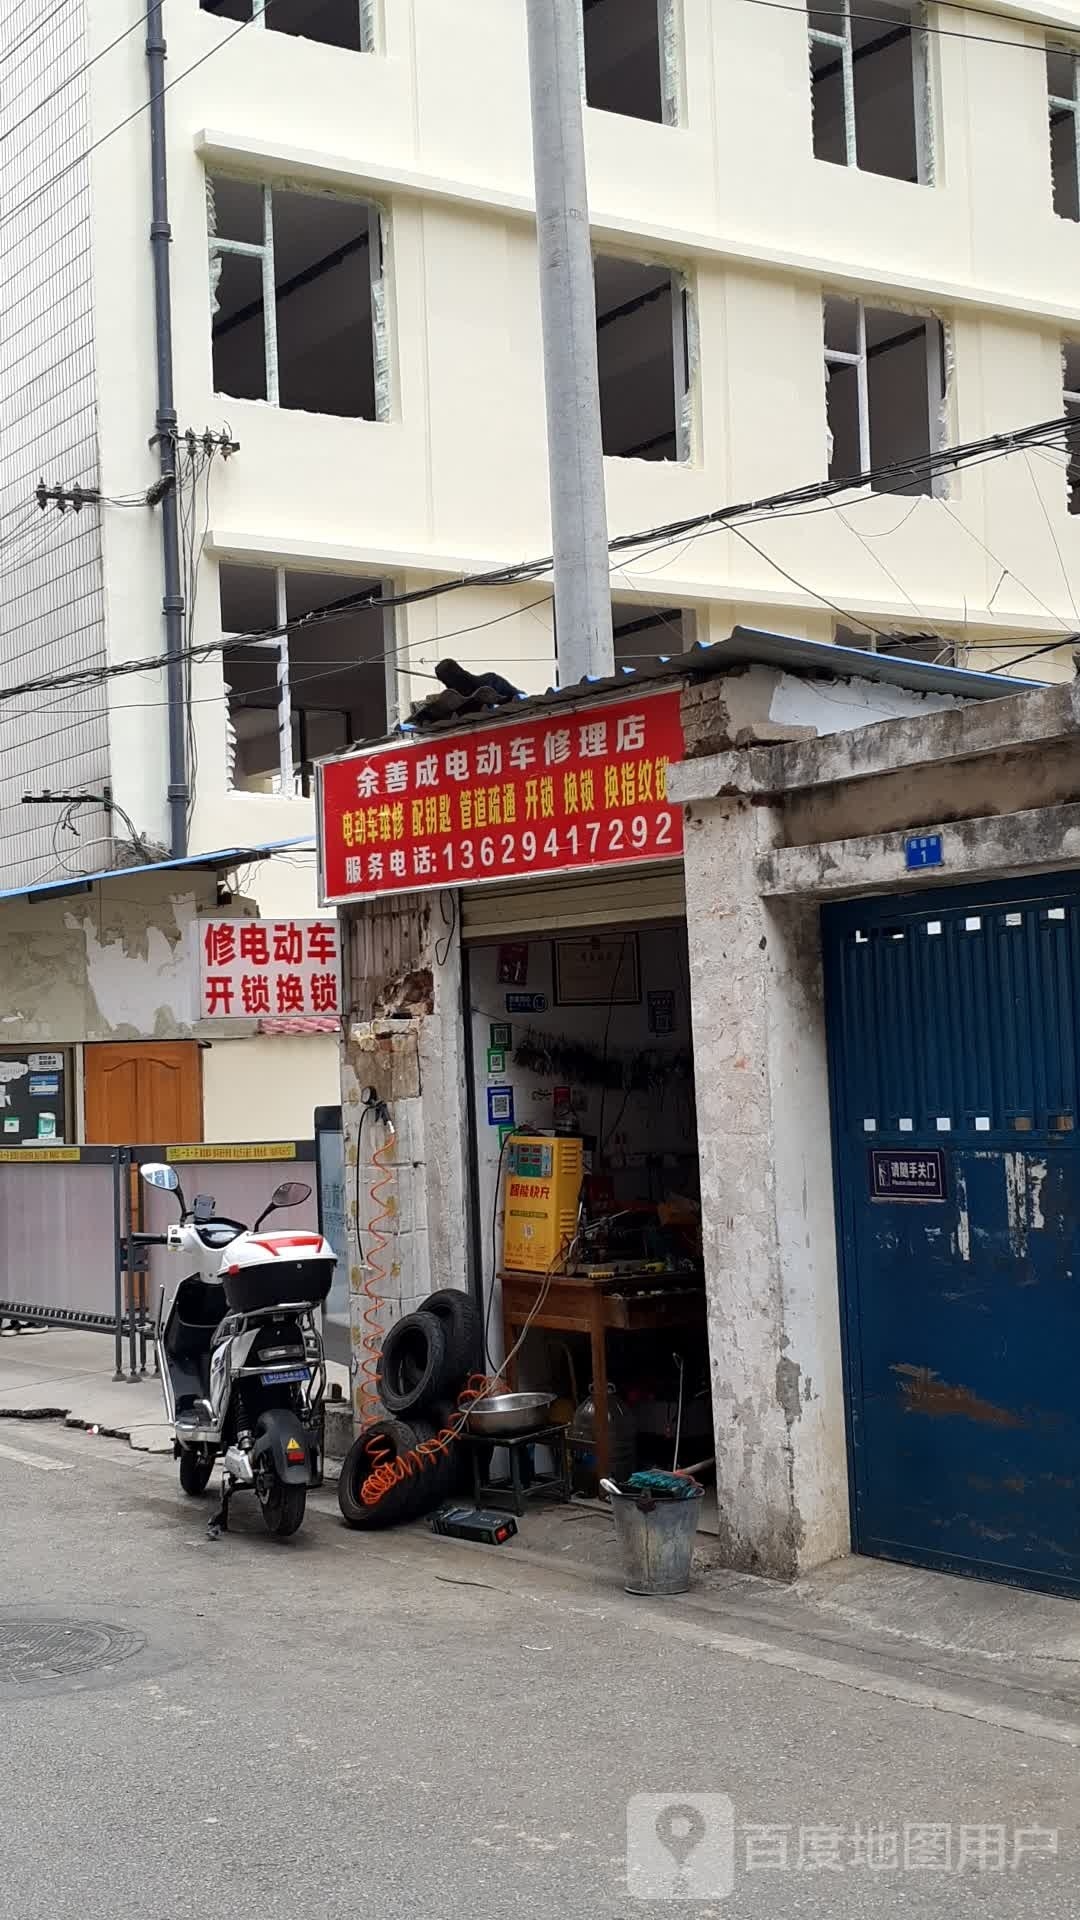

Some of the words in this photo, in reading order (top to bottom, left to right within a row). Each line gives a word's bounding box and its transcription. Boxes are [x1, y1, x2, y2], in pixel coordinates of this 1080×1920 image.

[357, 714, 646, 799] 余善成电动车修理店
[342, 803, 404, 848] 电动车维修
[411, 792, 452, 837] 配钥匙
[459, 783, 517, 831] 管道疏通
[525, 776, 554, 821] 开锁
[563, 769, 595, 815] 换锁
[604, 755, 670, 810] 换指纹锁
[205, 922, 336, 966] 修电动车
[205, 973, 338, 1015] 开锁换锁
[891, 1161, 936, 1178] 请随手关门
